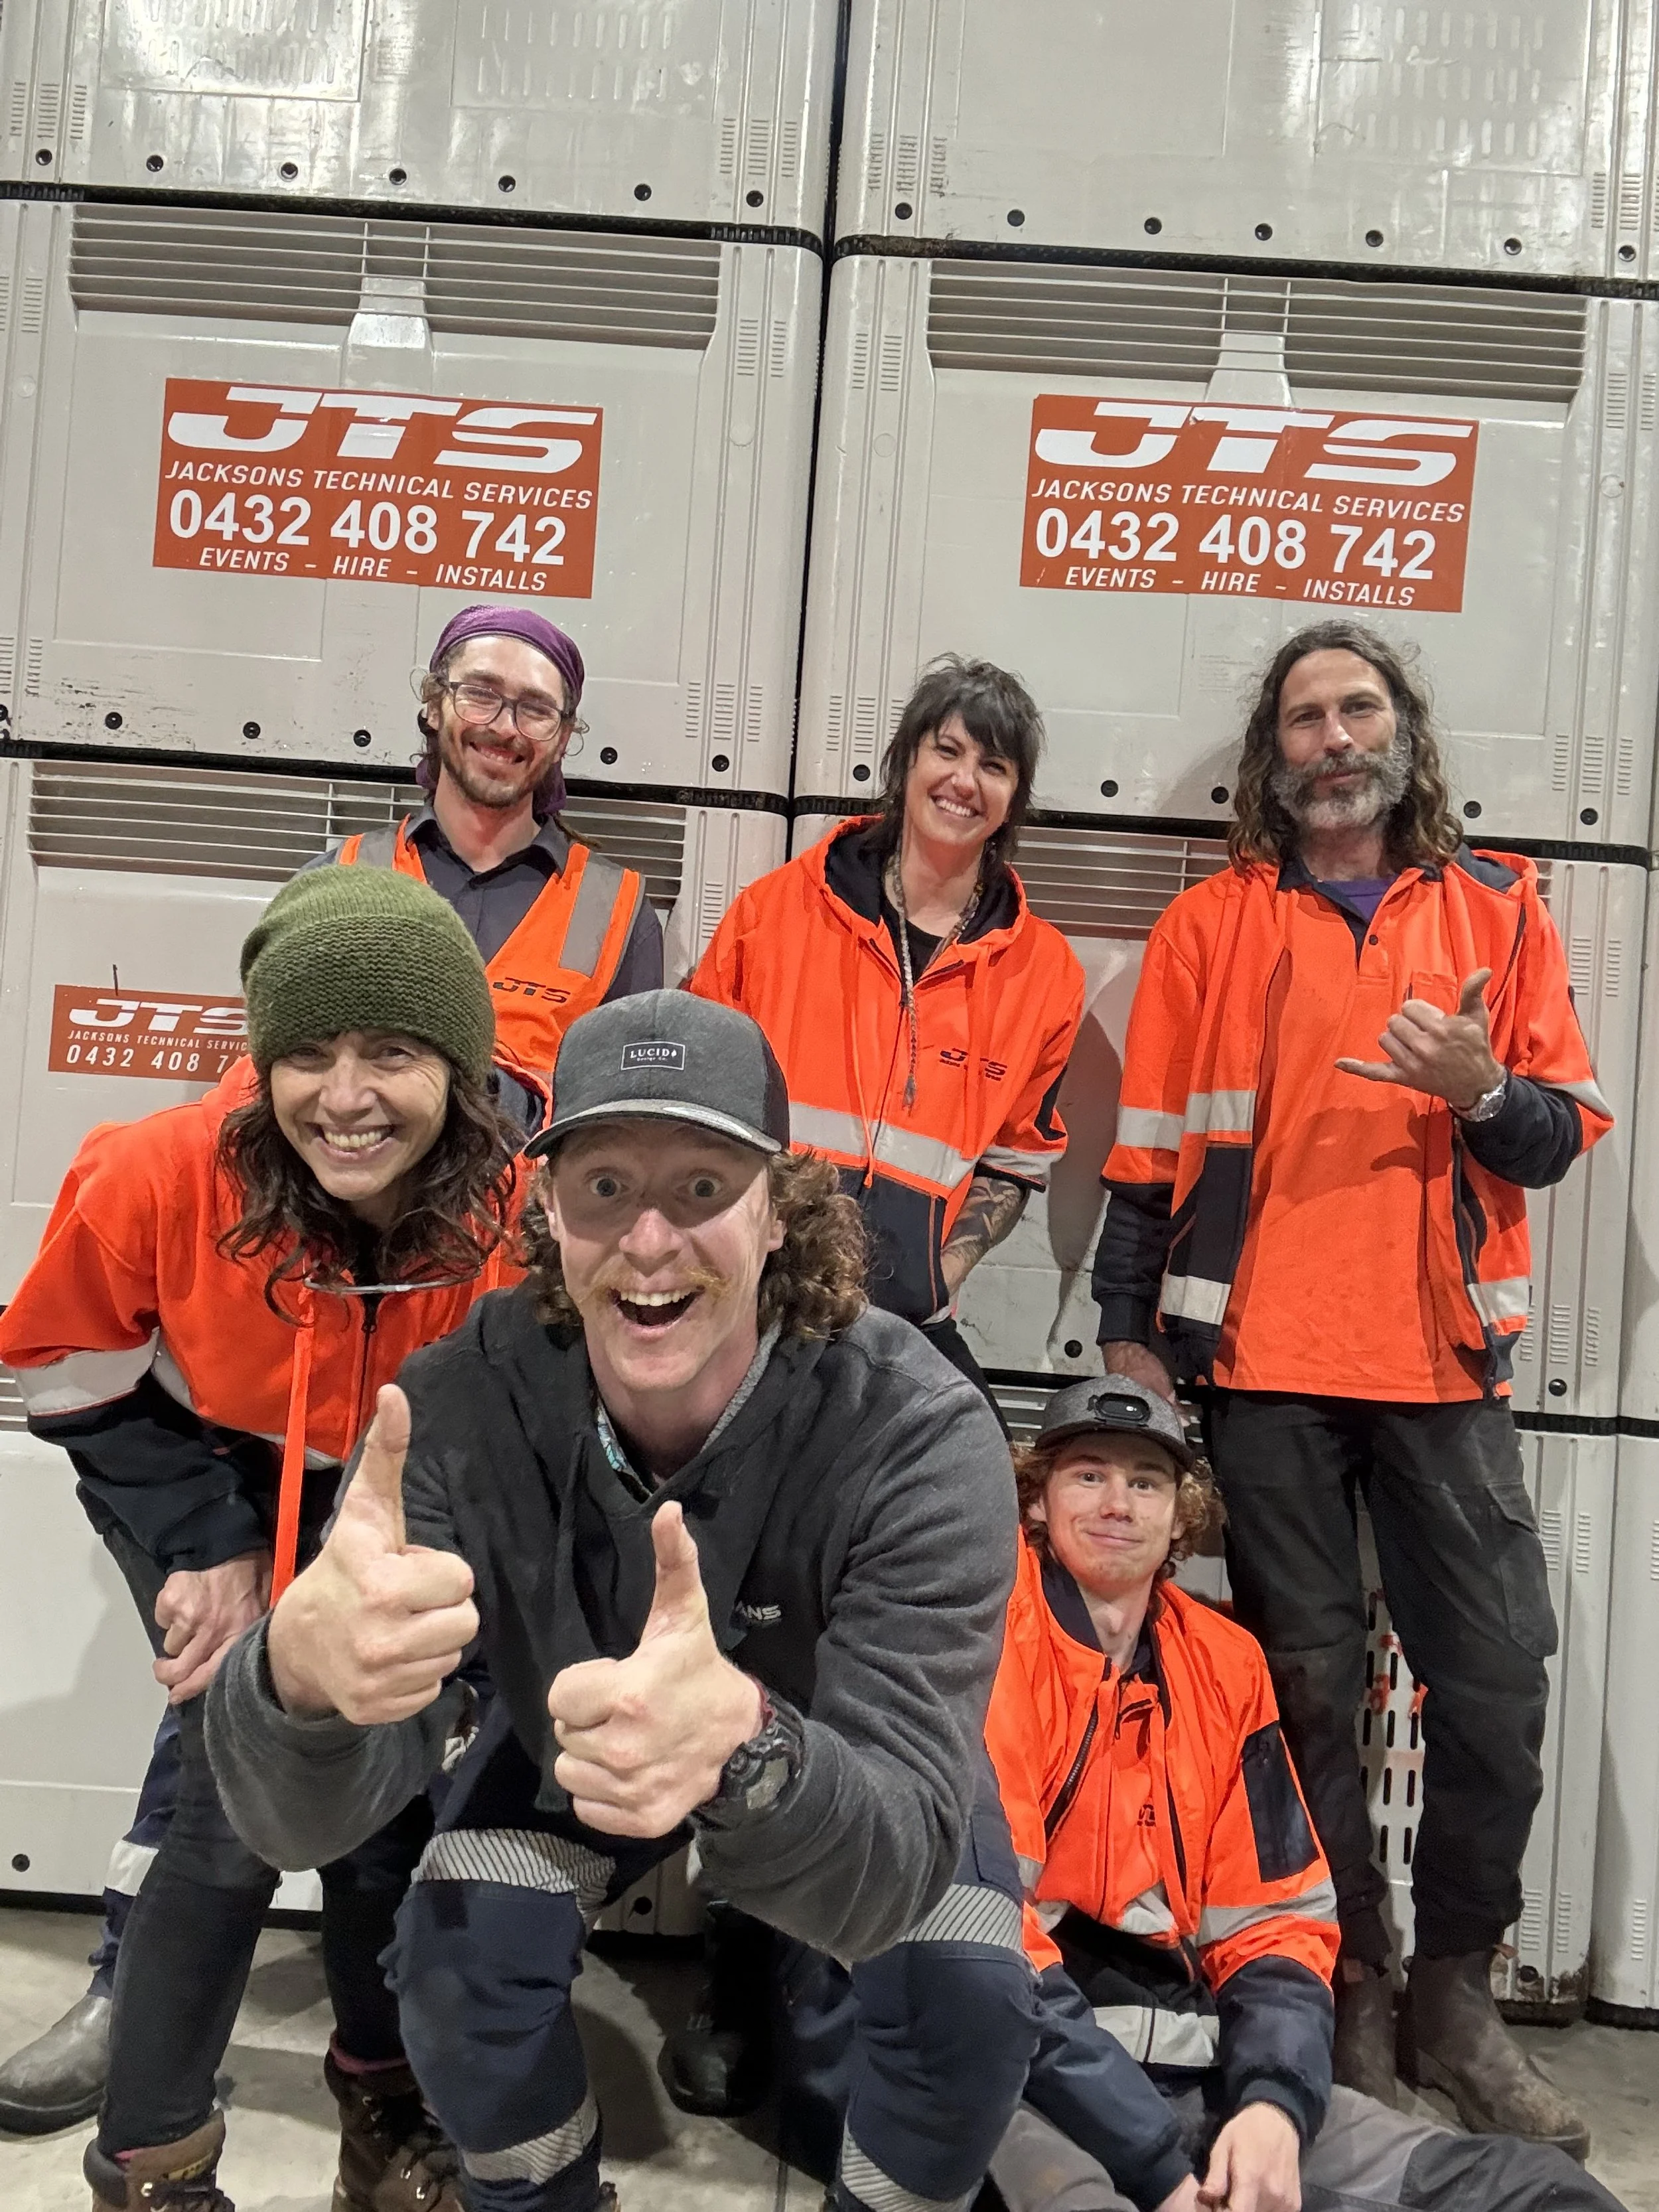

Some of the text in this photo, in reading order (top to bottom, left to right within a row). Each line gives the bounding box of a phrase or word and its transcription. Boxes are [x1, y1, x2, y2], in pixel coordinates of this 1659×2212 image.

[167, 386, 598, 474] JTS
[1035, 401, 1474, 487] JTS
[165, 461, 593, 509] JACKSONS TECHNICAL SERVICES
[1031, 479, 1465, 523] JACKSONS TECHNICAL SERVICES
[170, 489, 566, 565] 0432 408 742
[1036, 508, 1436, 580] 0432 408 742
[199, 547, 290, 571] EVENTS
[332, 555, 392, 577] HIRE
[435, 563, 547, 591] INSTALLS
[1065, 566, 1157, 589] EVENTS
[1200, 571, 1262, 593] HIRE
[1302, 578, 1415, 607] INSTALLS
[492, 977, 571, 1003] JTS
[68, 998, 250, 1036] JTS
[66, 1044, 134, 1067] 0432
[151, 1051, 200, 1072] 408
[68, 1030, 248, 1051] JACKSONS TECHNICAL SERVIC
[630, 1047, 670, 1059] LUCID
[940, 1047, 1008, 1076] JS
[735, 1599, 782, 1620] ANS
